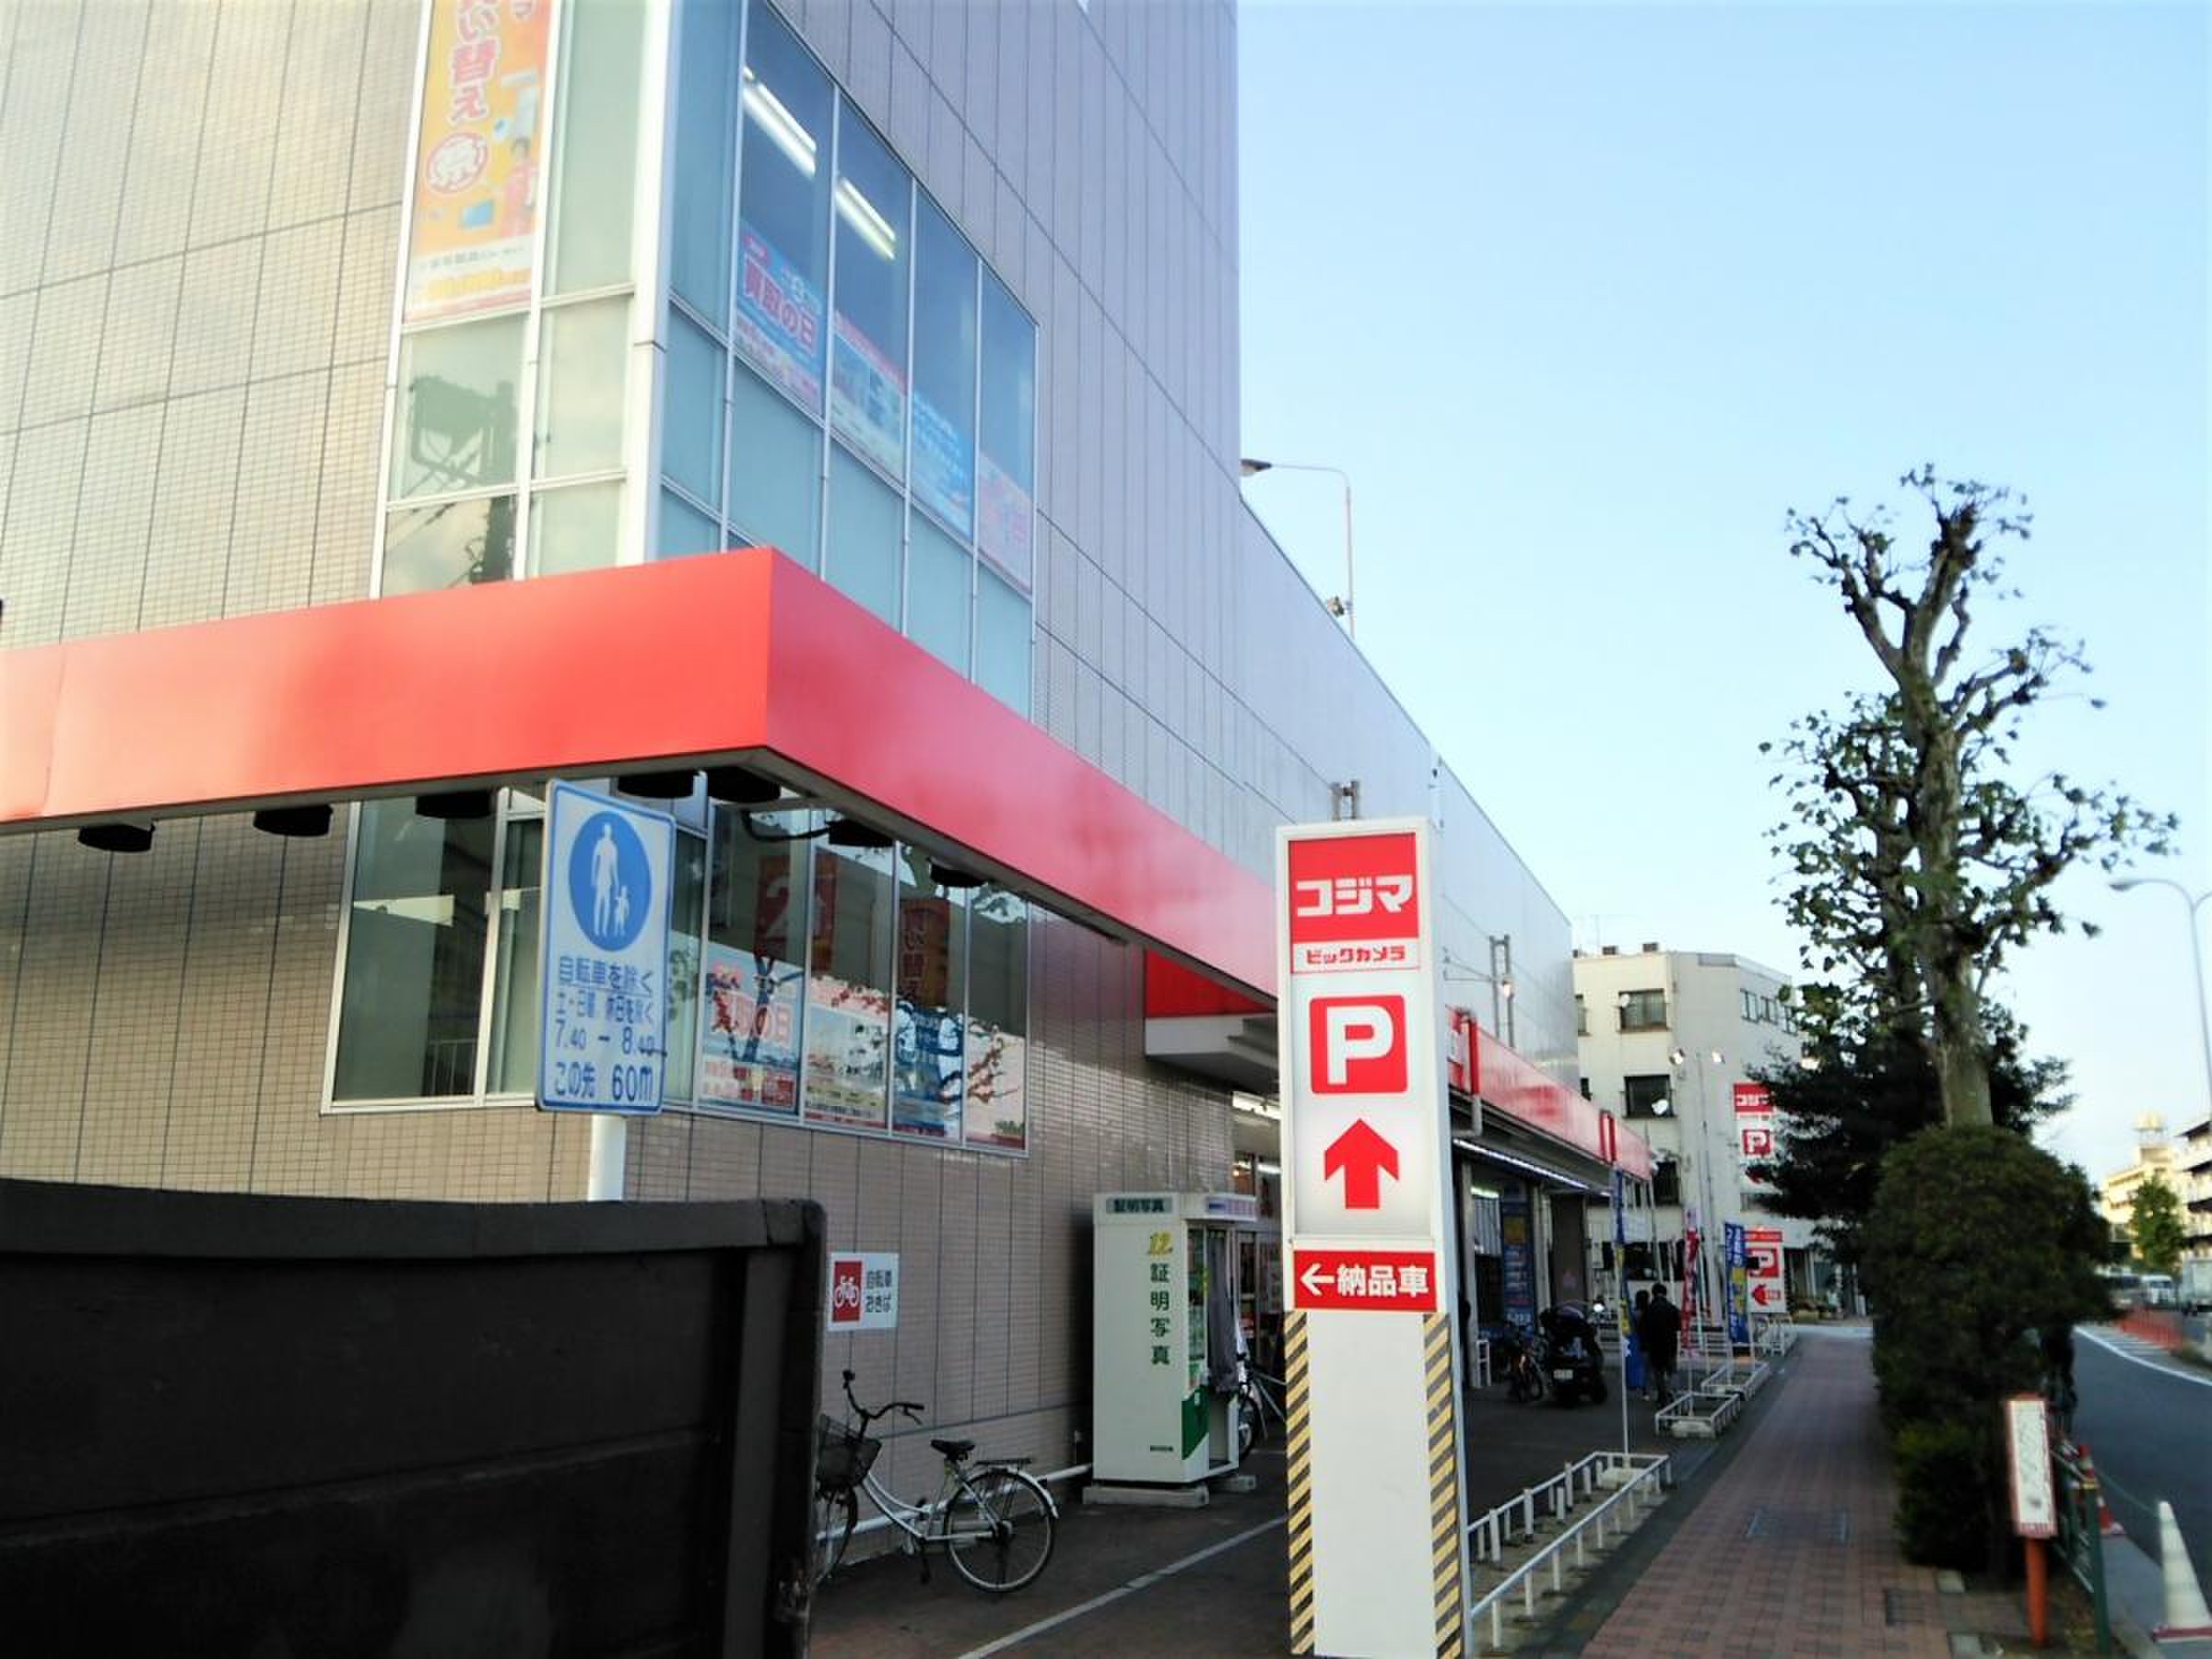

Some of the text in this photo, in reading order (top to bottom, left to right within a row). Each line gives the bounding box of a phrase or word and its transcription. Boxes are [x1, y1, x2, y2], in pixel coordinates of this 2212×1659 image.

[1297, 875, 1414, 918] コジマ
[1307, 945, 1406, 965] ビックカメラ
[1326, 1006, 1394, 1086] P
[554, 1061, 653, 1102] この先 60m
[1336, 1263, 1430, 1299] 納品車
[1149, 1262, 1171, 1366] 証明写真
